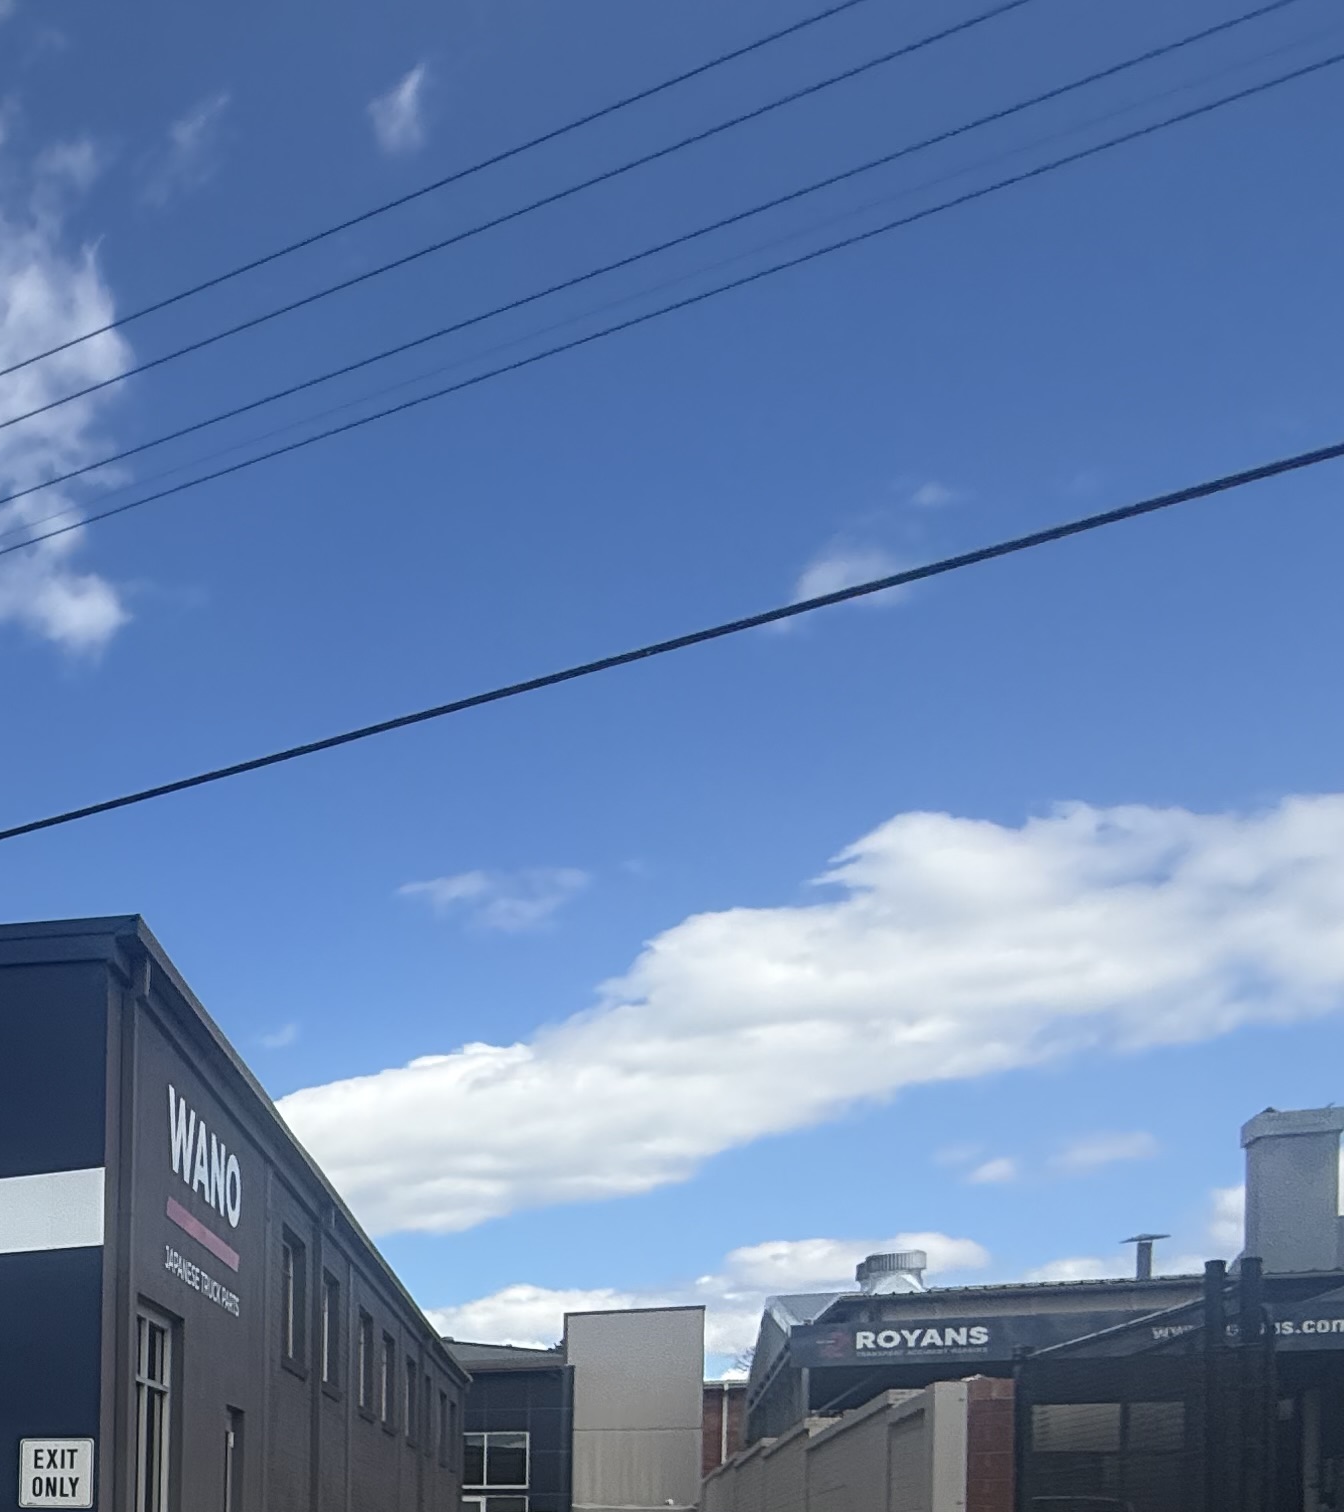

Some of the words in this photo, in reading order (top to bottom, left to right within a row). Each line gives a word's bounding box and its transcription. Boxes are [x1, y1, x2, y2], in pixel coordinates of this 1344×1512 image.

[168, 1084, 241, 1228] WANO
[855, 1326, 989, 1349] ROYANS
[33, 1448, 78, 1469] EXIT
[32, 1476, 80, 1497] ONLY
